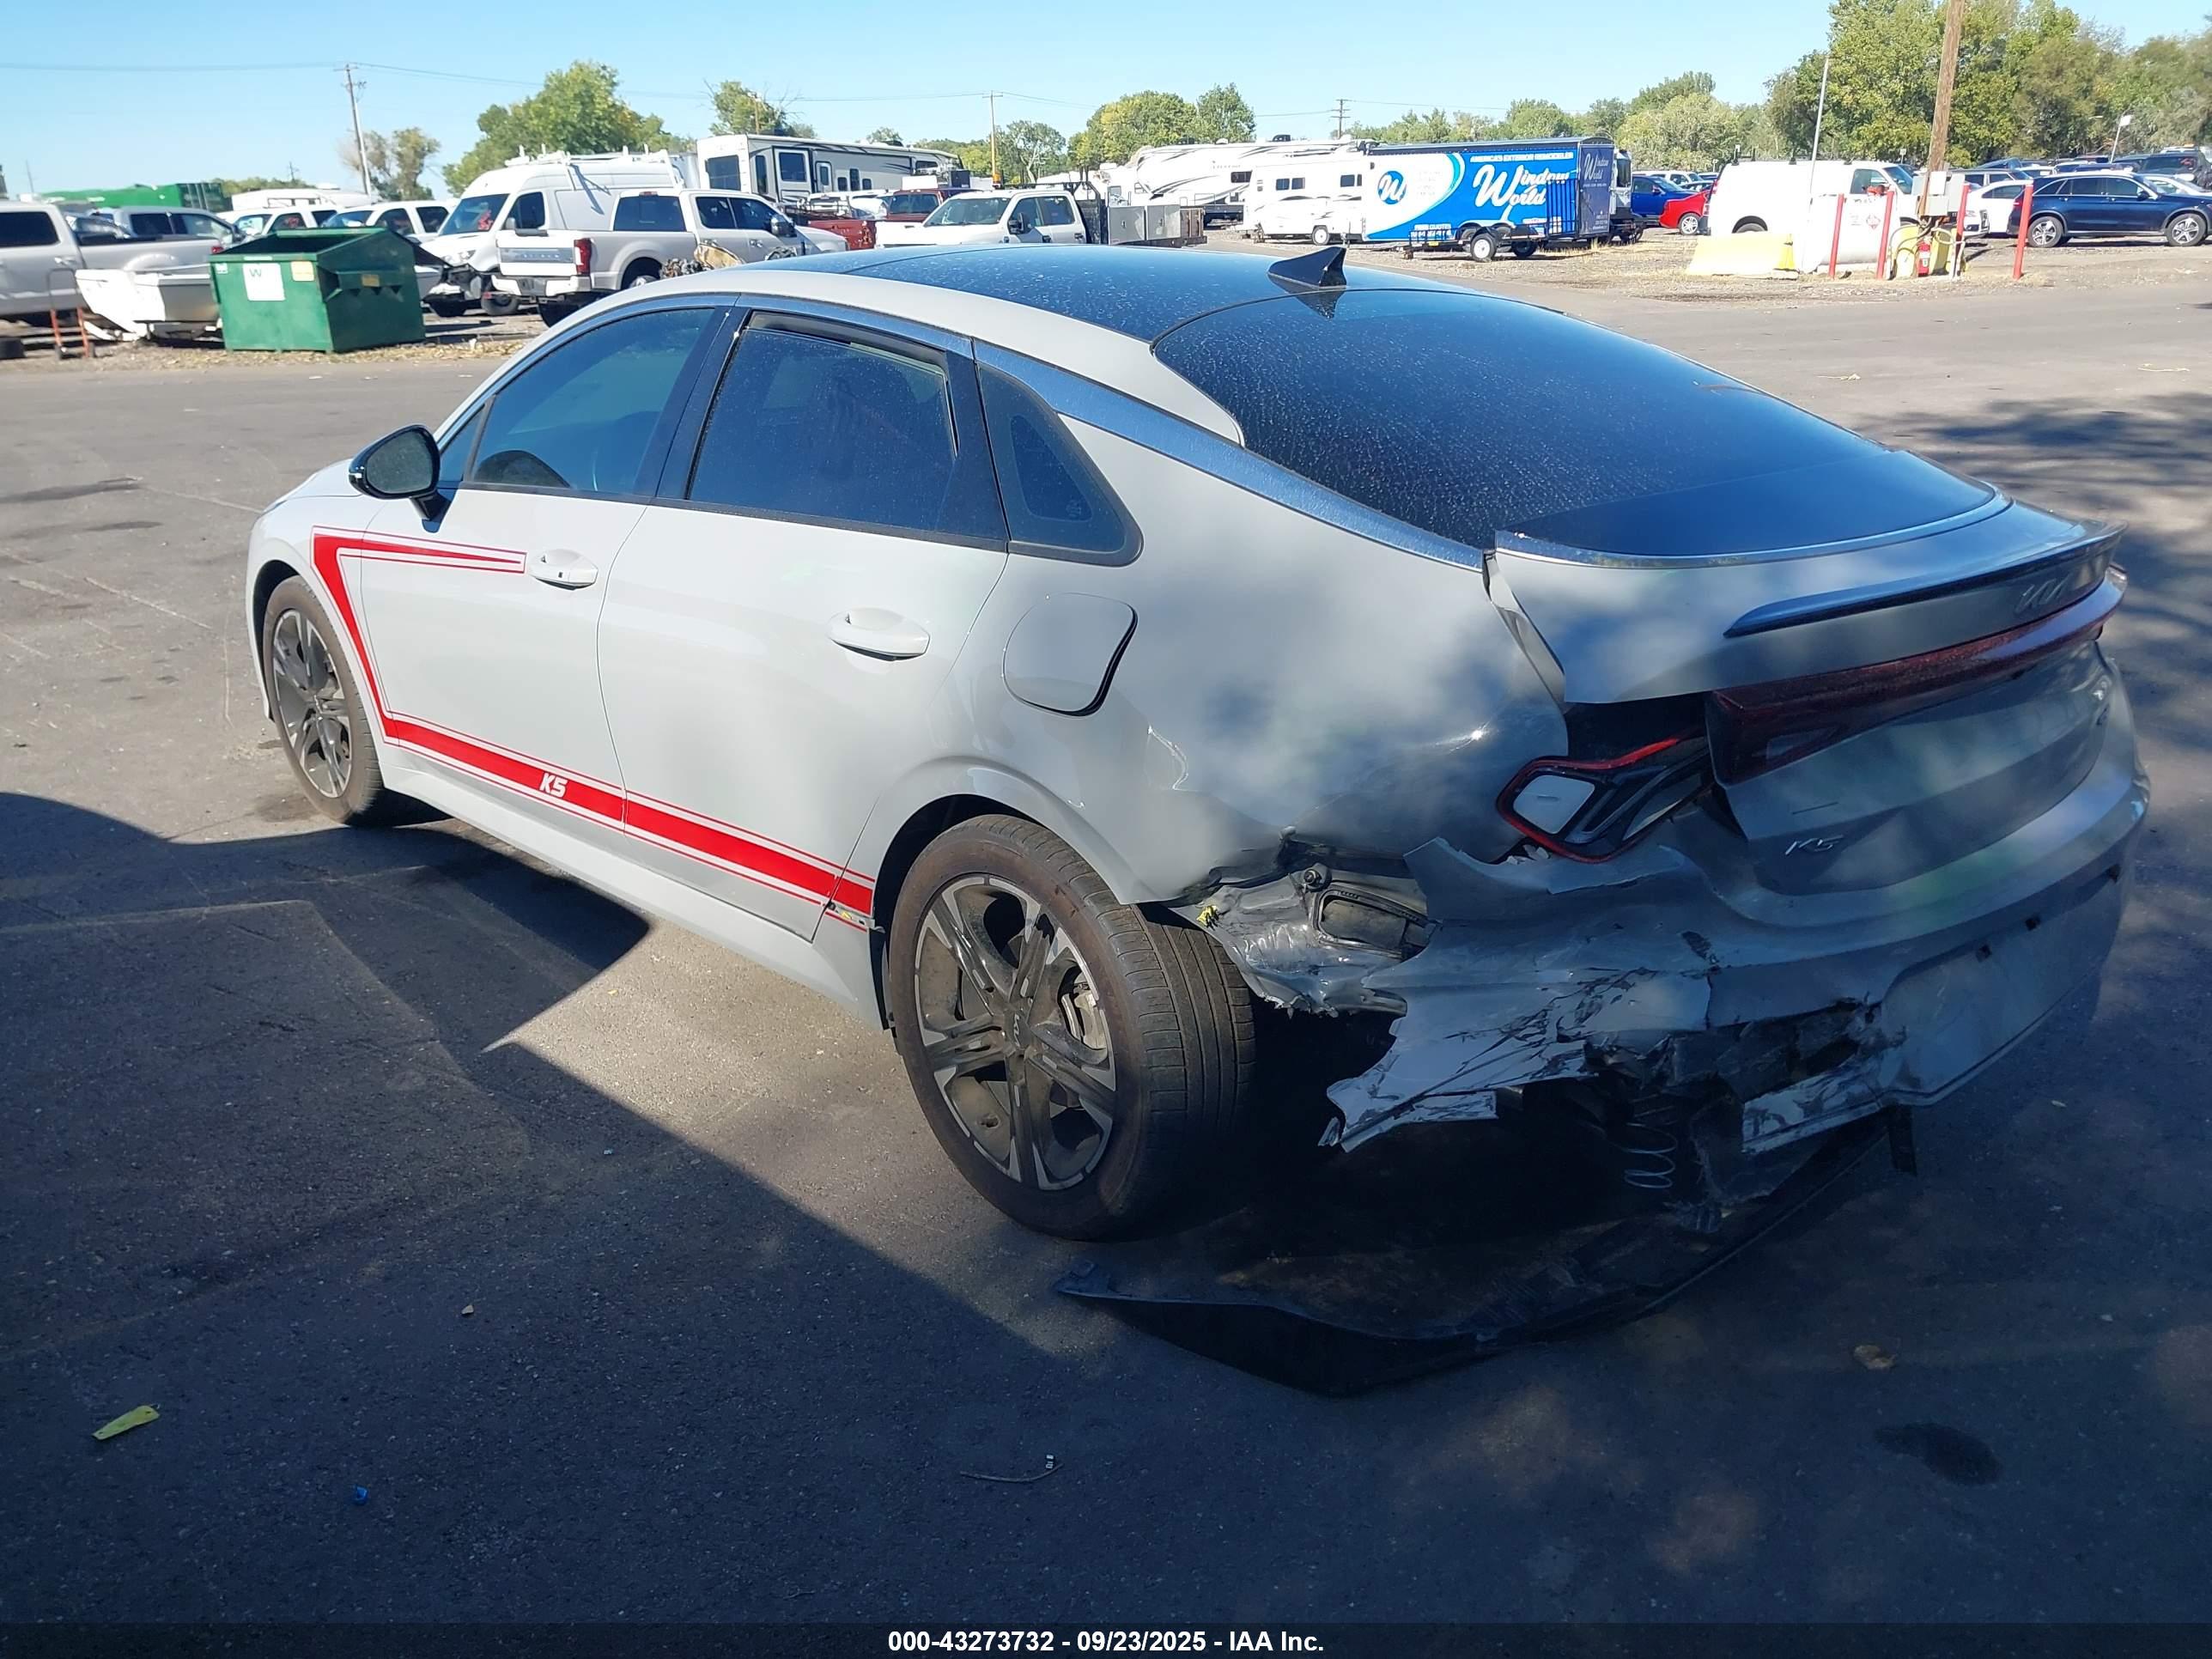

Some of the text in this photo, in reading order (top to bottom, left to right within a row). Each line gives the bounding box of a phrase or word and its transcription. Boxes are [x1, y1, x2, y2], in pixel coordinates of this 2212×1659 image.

[1473, 164, 1571, 207] Window
[539, 772, 568, 798] K5
[1785, 835, 1844, 855] K5
